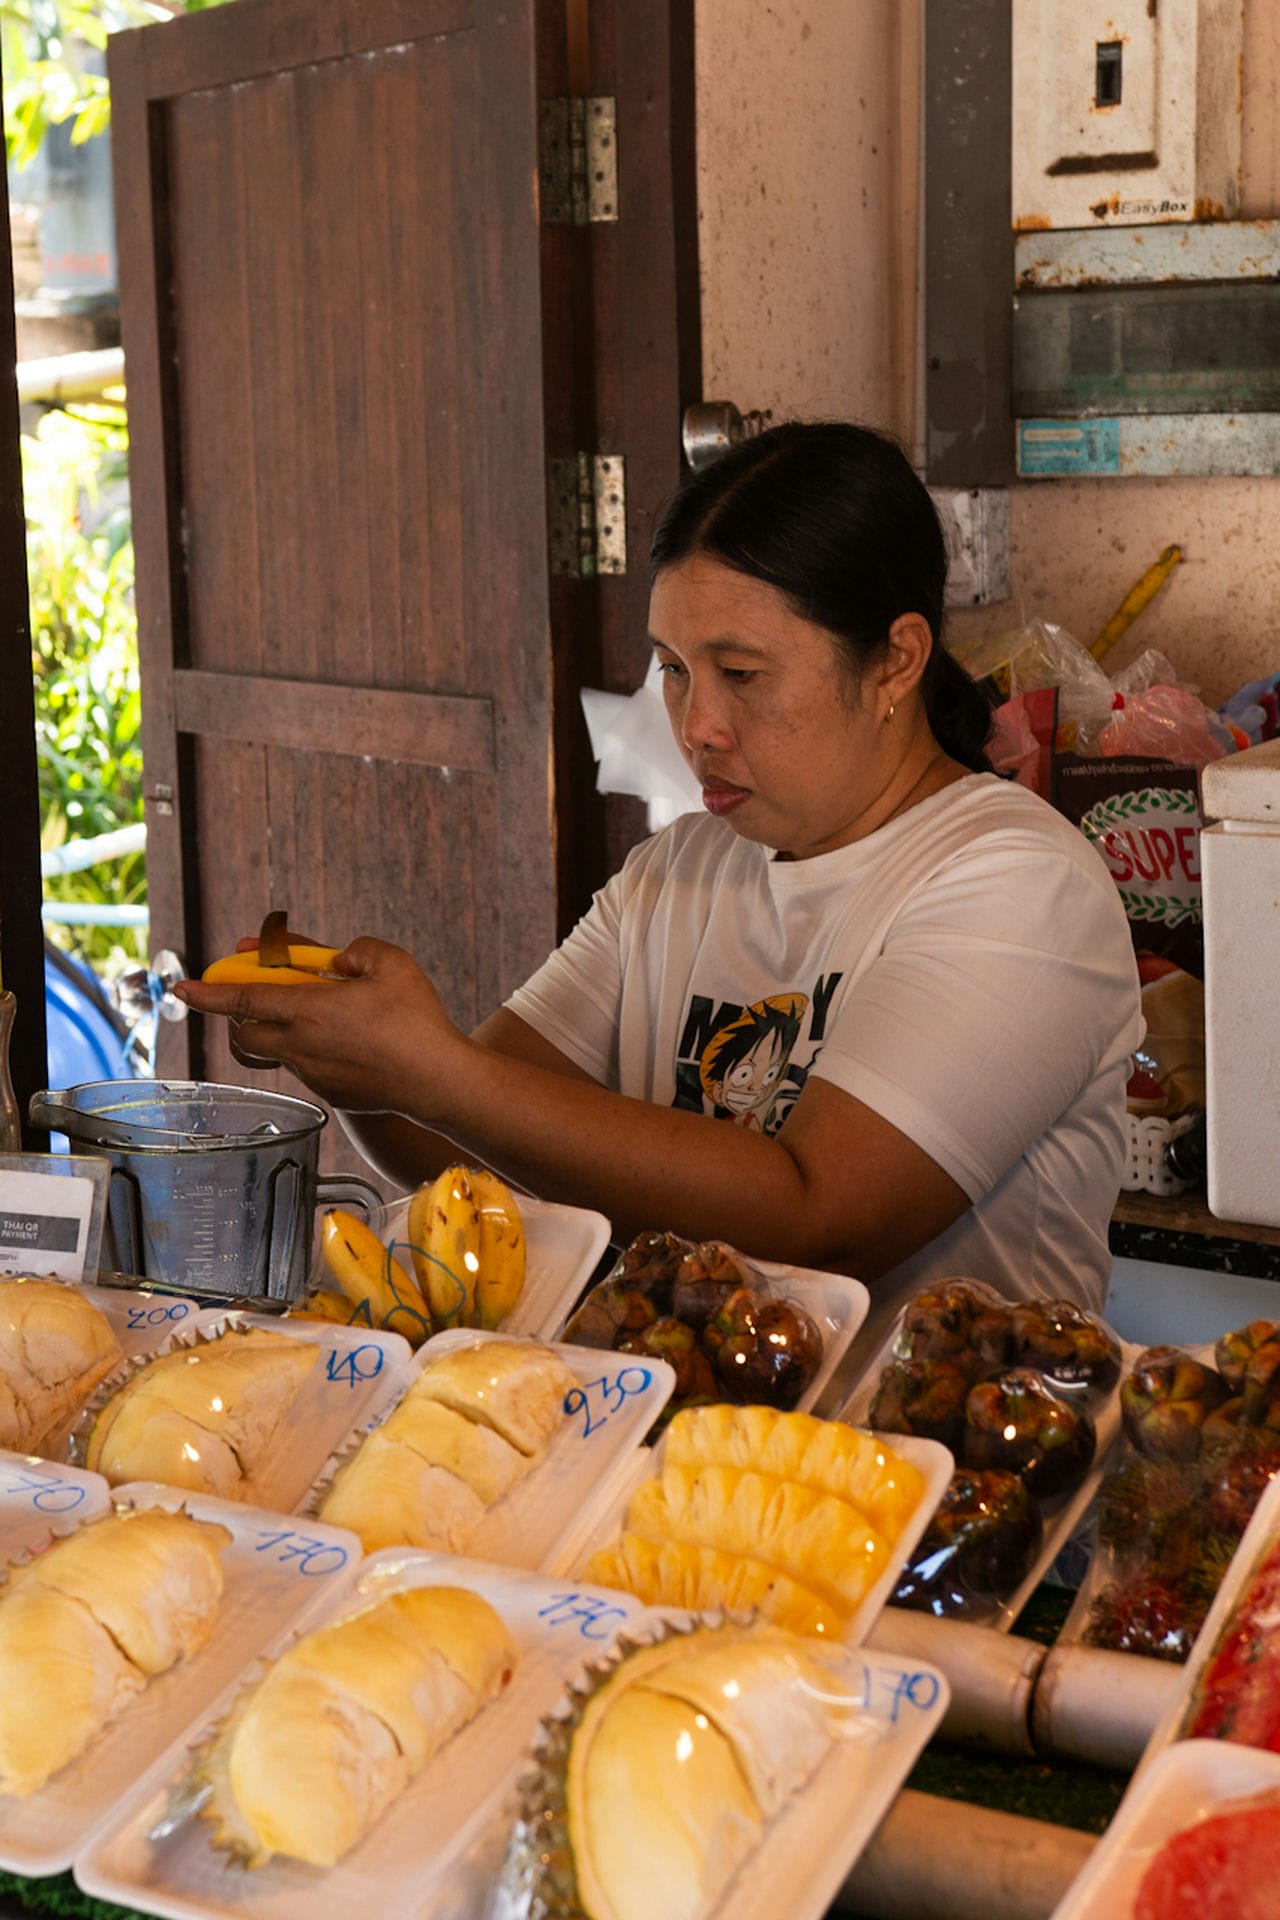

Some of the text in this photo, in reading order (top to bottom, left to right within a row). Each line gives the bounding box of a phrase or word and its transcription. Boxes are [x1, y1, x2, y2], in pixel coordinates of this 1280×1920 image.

[1120, 200, 1189, 216] EasyBox
[1104, 827, 1202, 882] SUPE
[1, 1230, 38, 1240] PAYMENT
[3, 1220, 39, 1231] THAI QR
[127, 1303, 189, 1329] 200
[563, 1367, 653, 1439] 230
[255, 1531, 348, 1577] 170
[863, 1667, 940, 1723] 170
